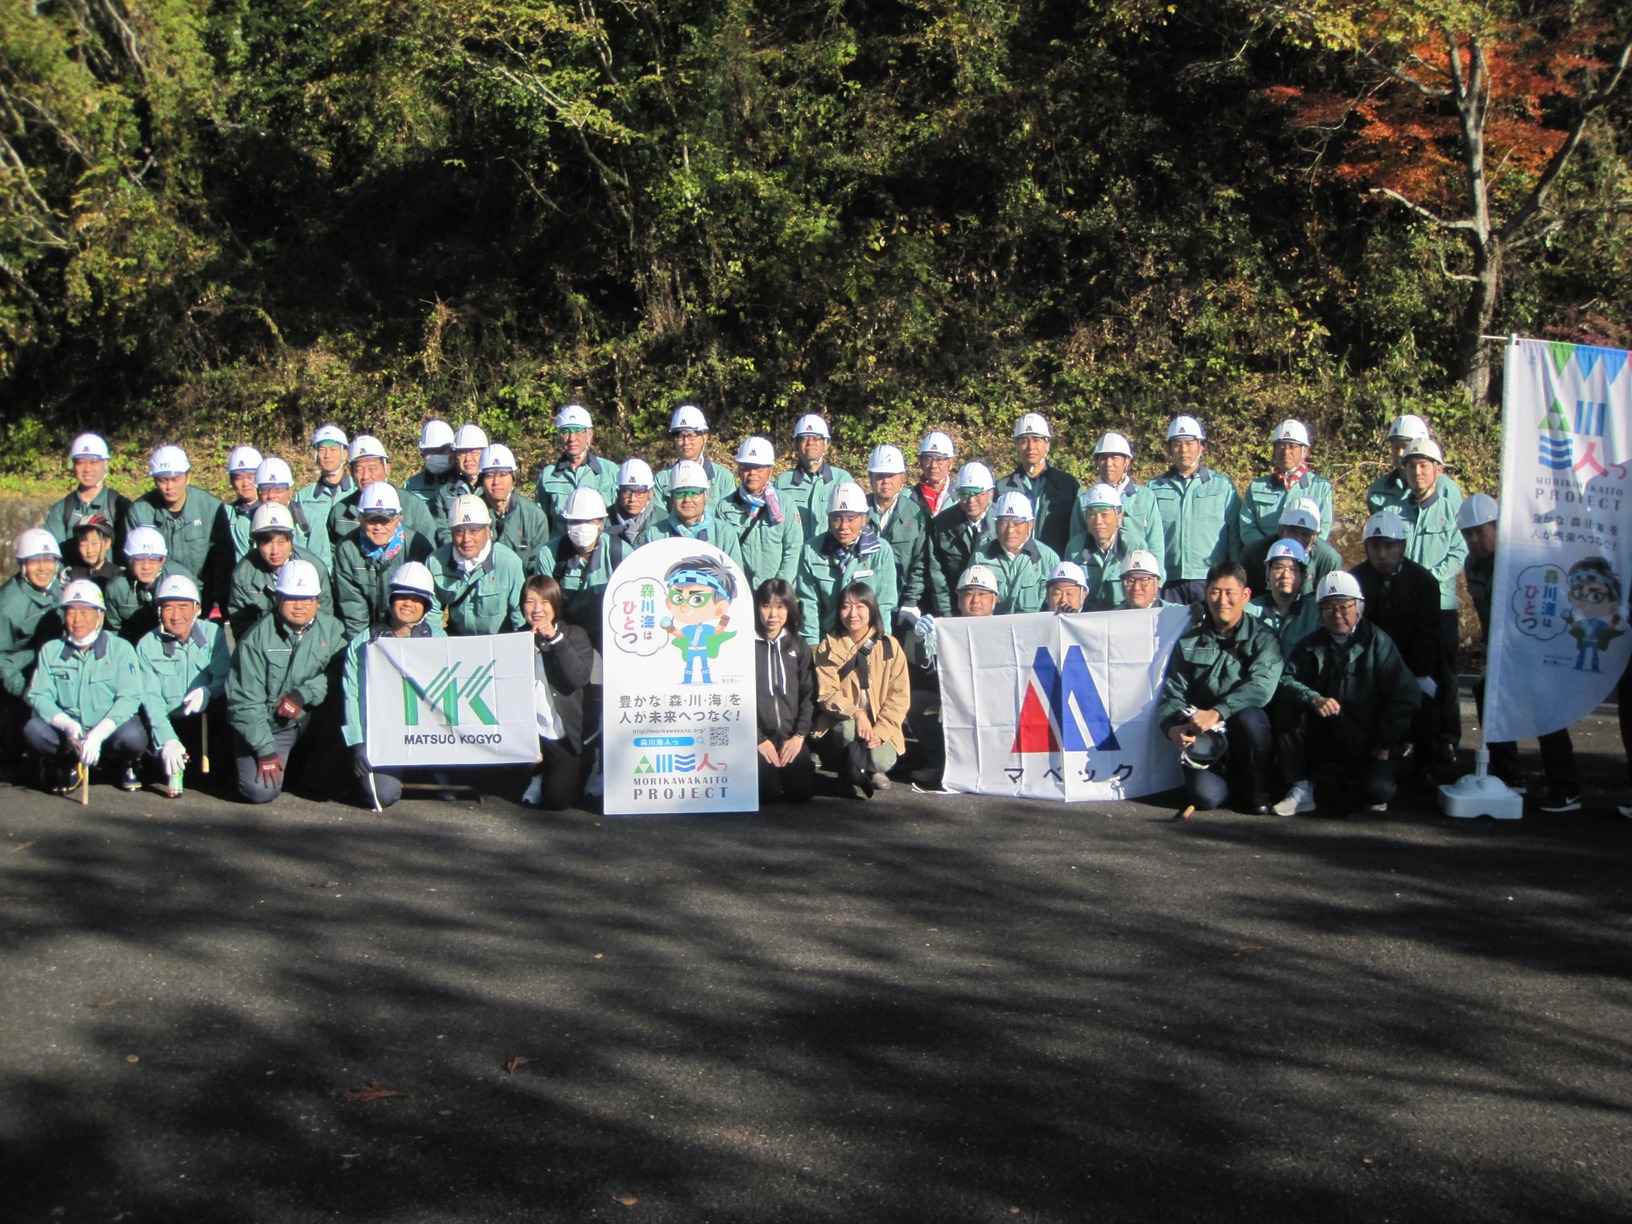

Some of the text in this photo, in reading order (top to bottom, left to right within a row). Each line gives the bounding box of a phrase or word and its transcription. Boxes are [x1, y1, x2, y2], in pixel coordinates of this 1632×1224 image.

[1536, 477, 1623, 496] MORIKWKAITO
[1522, 585, 1539, 629] ひとつ
[1541, 569, 1559, 628] 森川海は
[640, 584, 655, 640] 森川海は
[622, 601, 638, 644] ひとつ
[404, 733, 502, 745] MATSUO KOGYO
[633, 776, 728, 786] MORIKAWAKAITO
[1003, 764, 1134, 784] マベック
[633, 787, 728, 800] PROJECT
